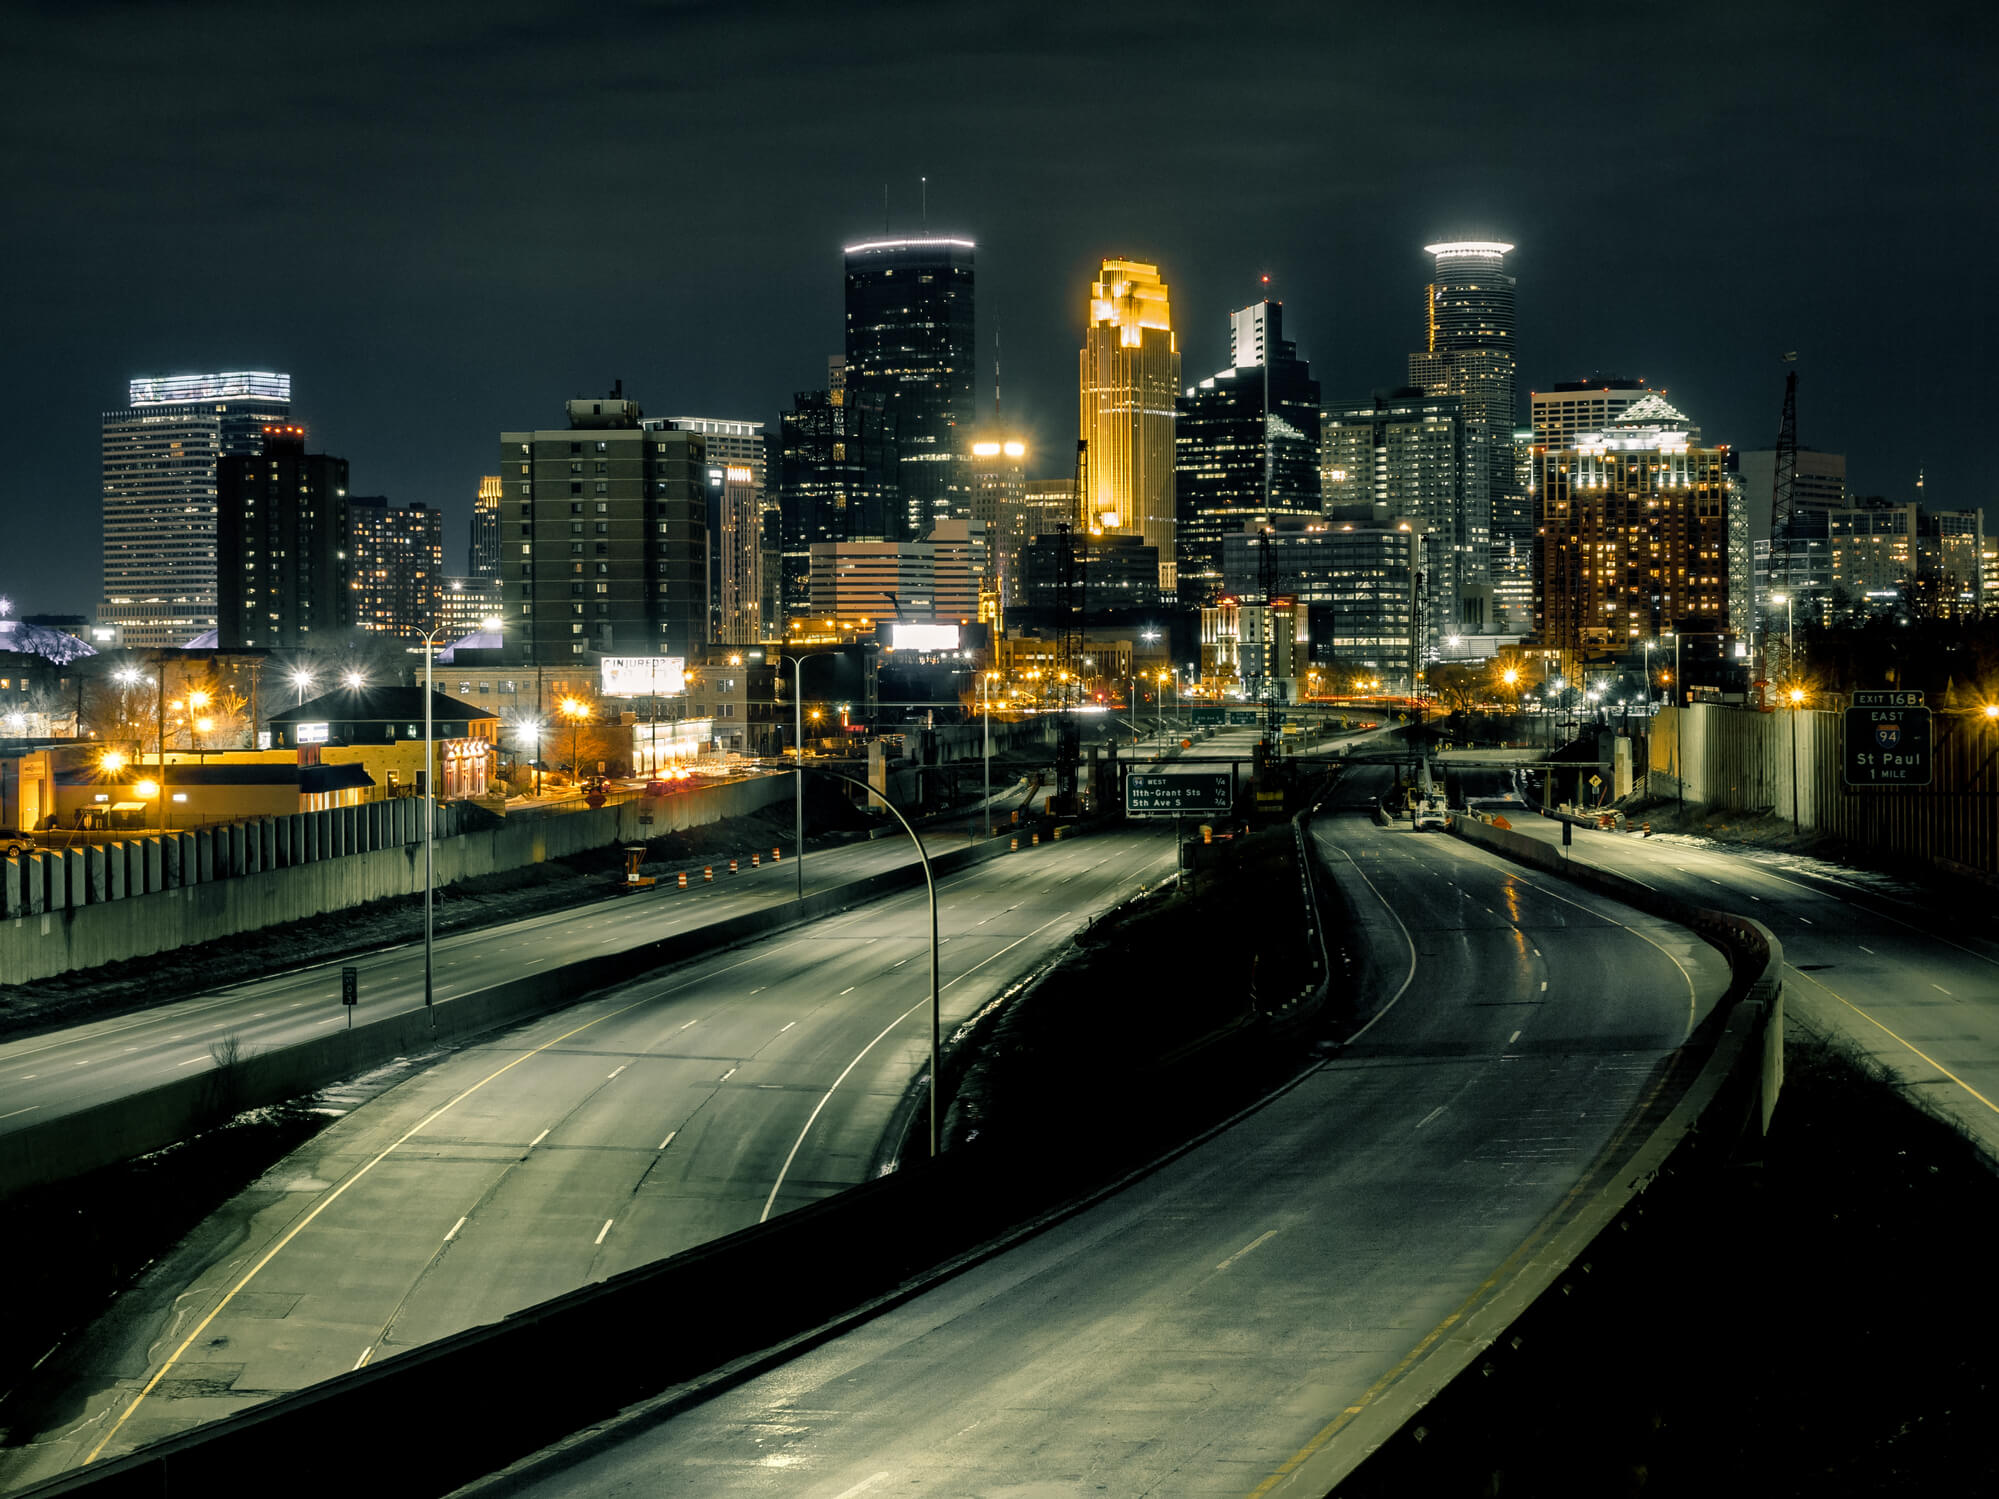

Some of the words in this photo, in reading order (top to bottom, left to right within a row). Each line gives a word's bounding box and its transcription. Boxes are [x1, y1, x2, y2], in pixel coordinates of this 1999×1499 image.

[1859, 695, 1884, 704] EXIT
[1889, 693, 1917, 705] 16B
[1871, 711, 1905, 721] EAST
[1879, 731, 1897, 743] 94
[1857, 753, 1875, 765] St
[1883, 753, 1920, 765] Paul
[1870, 769, 1875, 780] 1
[1881, 770, 1907, 778] MILE
[1132, 789, 1181, 797] 11th-Grant
[1186, 788, 1201, 796] Sts
[1132, 799, 1149, 807] 5th
[1153, 799, 1171, 807] Ave
